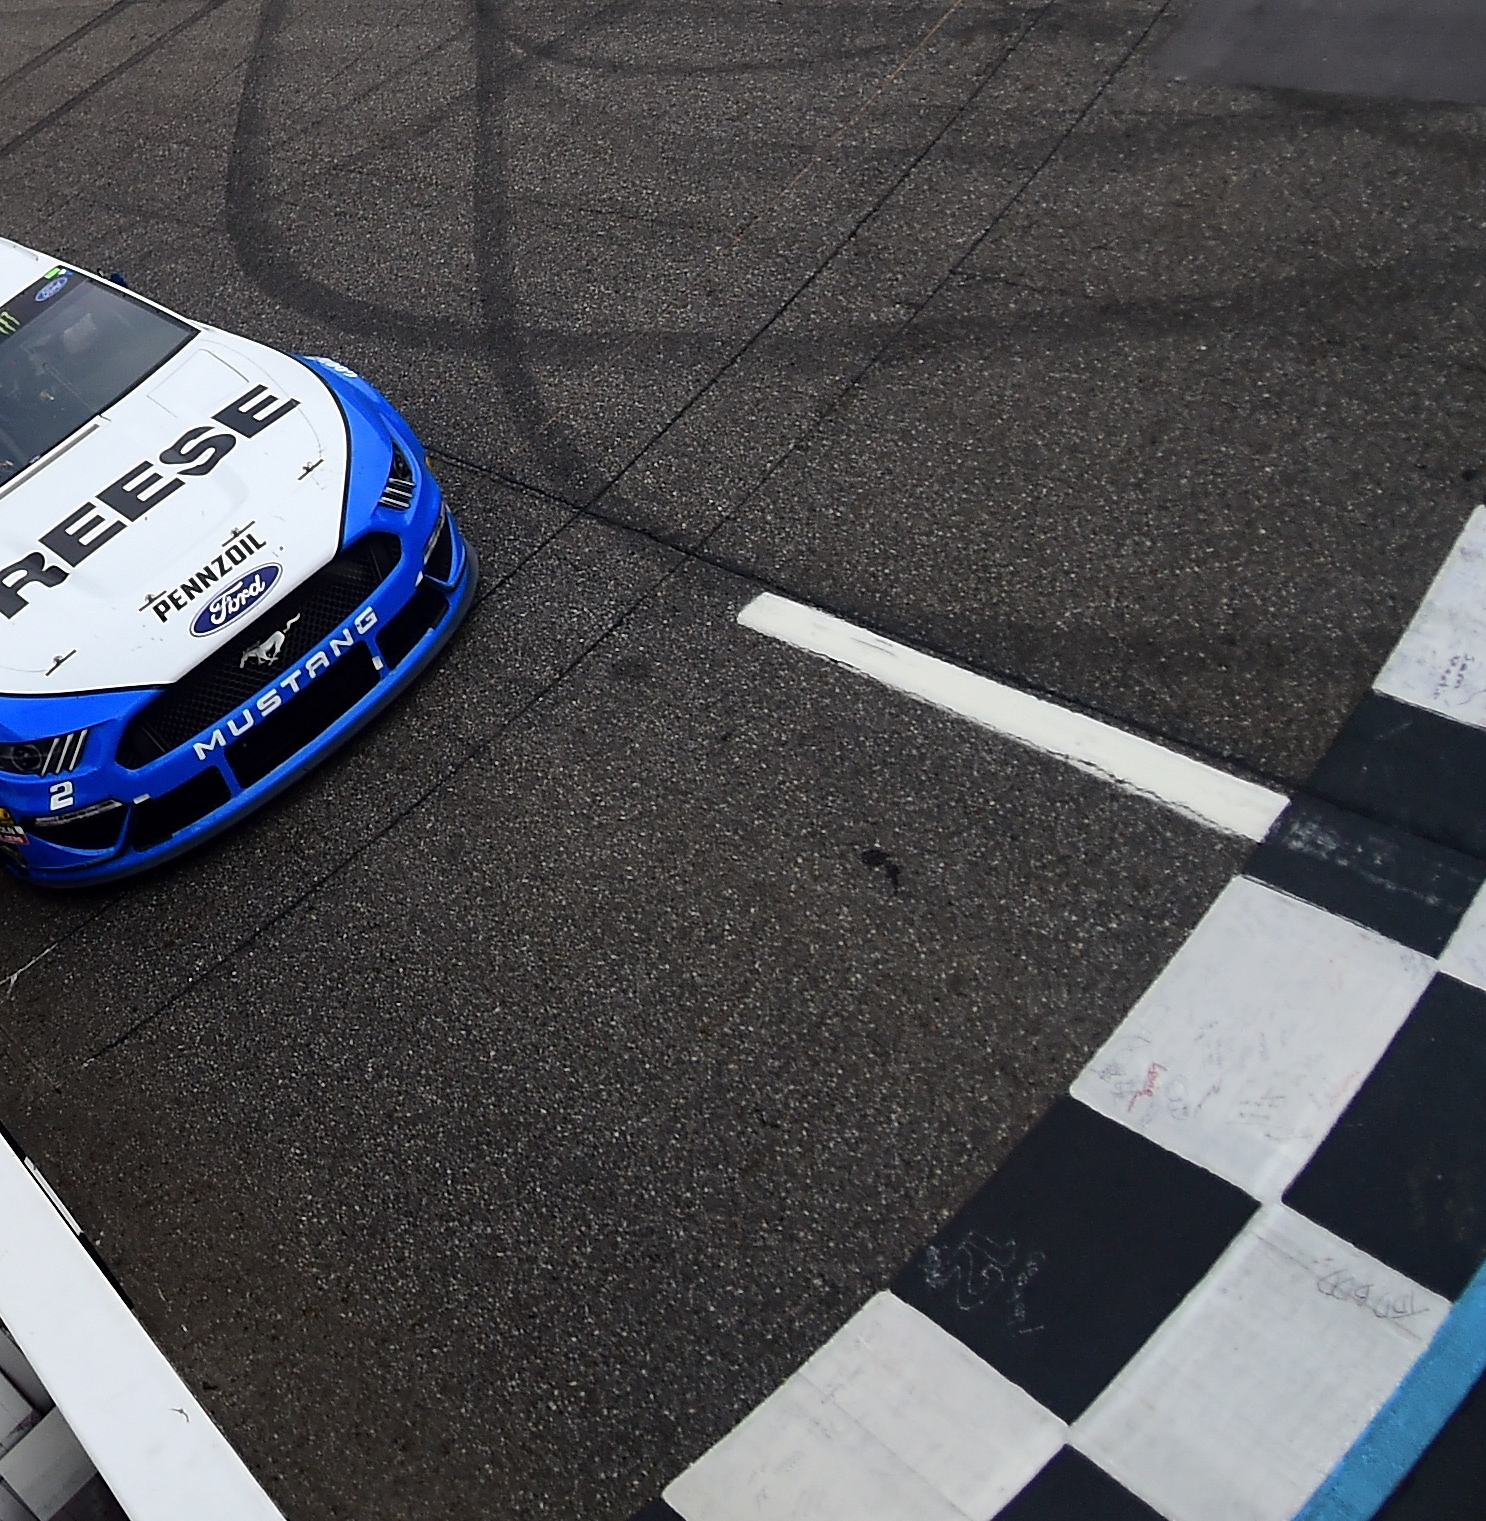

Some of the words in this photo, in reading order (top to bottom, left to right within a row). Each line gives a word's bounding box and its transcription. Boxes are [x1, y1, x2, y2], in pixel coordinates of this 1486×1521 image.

[152, 531, 267, 624] PENNZOIL
[209, 574, 266, 626] Ford
[192, 606, 378, 761] MUSTANG
[49, 780, 74, 811] 2
